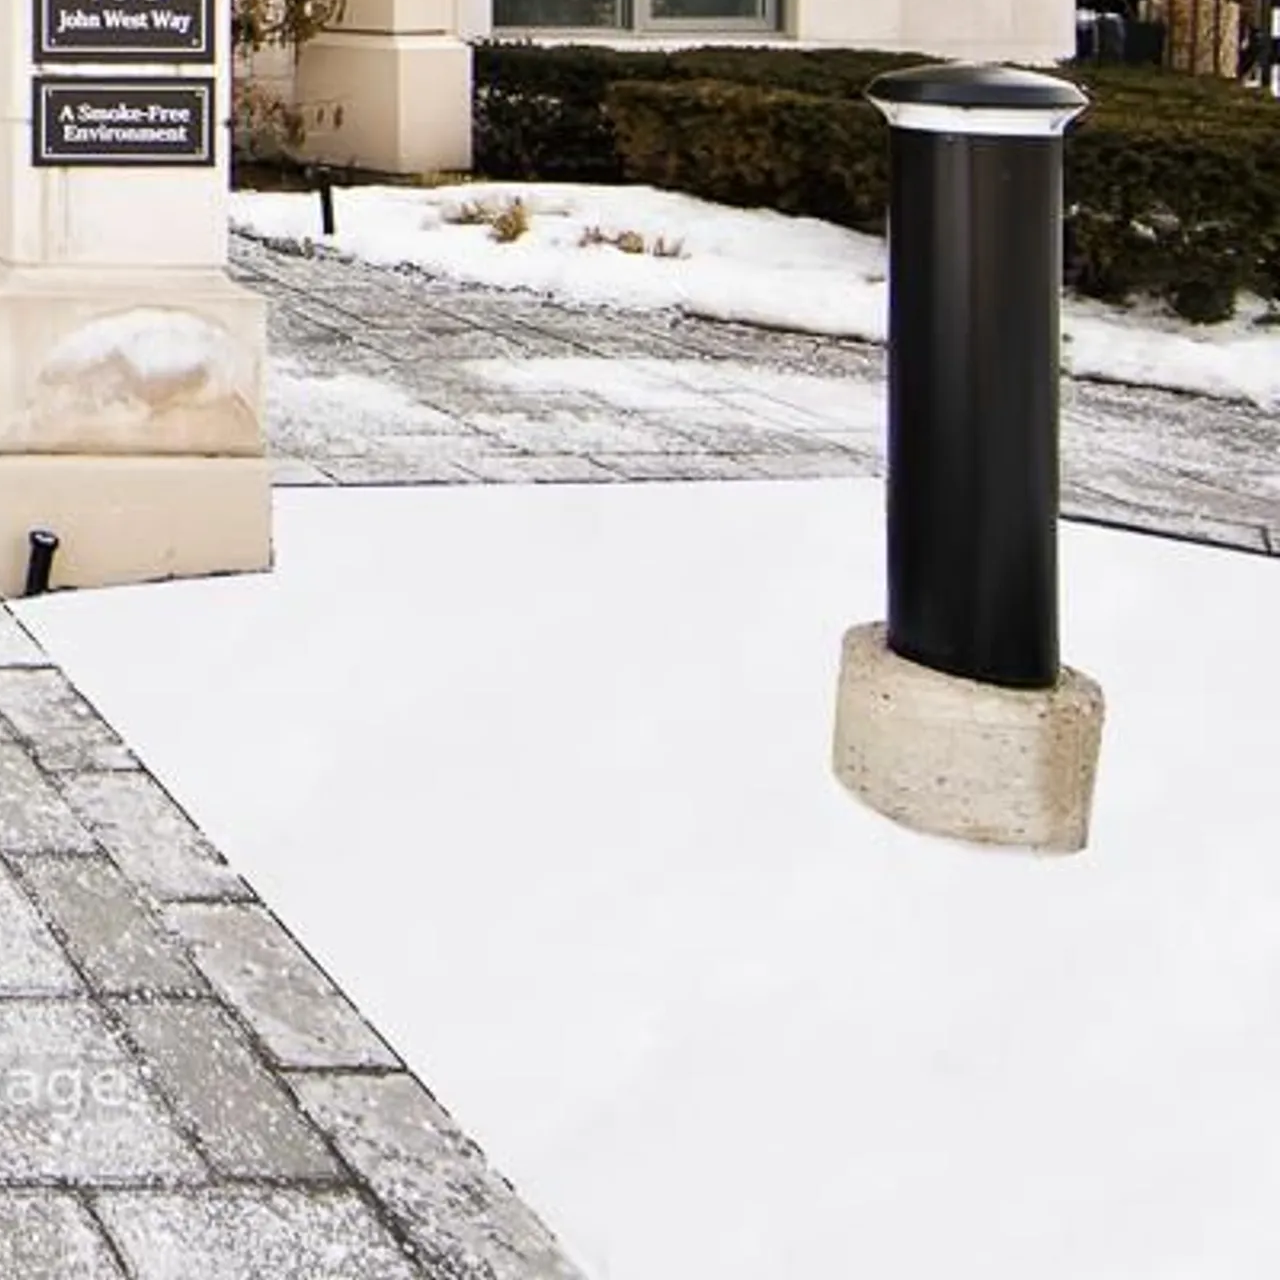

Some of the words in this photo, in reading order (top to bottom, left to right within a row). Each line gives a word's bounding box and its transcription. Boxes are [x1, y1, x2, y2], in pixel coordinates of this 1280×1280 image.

[57, 9, 100, 33] John
[102, 9, 148, 29] West
[150, 9, 192, 34] Way
[59, 105, 75, 122] A
[77, 102, 190, 122] Smoke-Free
[64, 123, 188, 142] Environment
